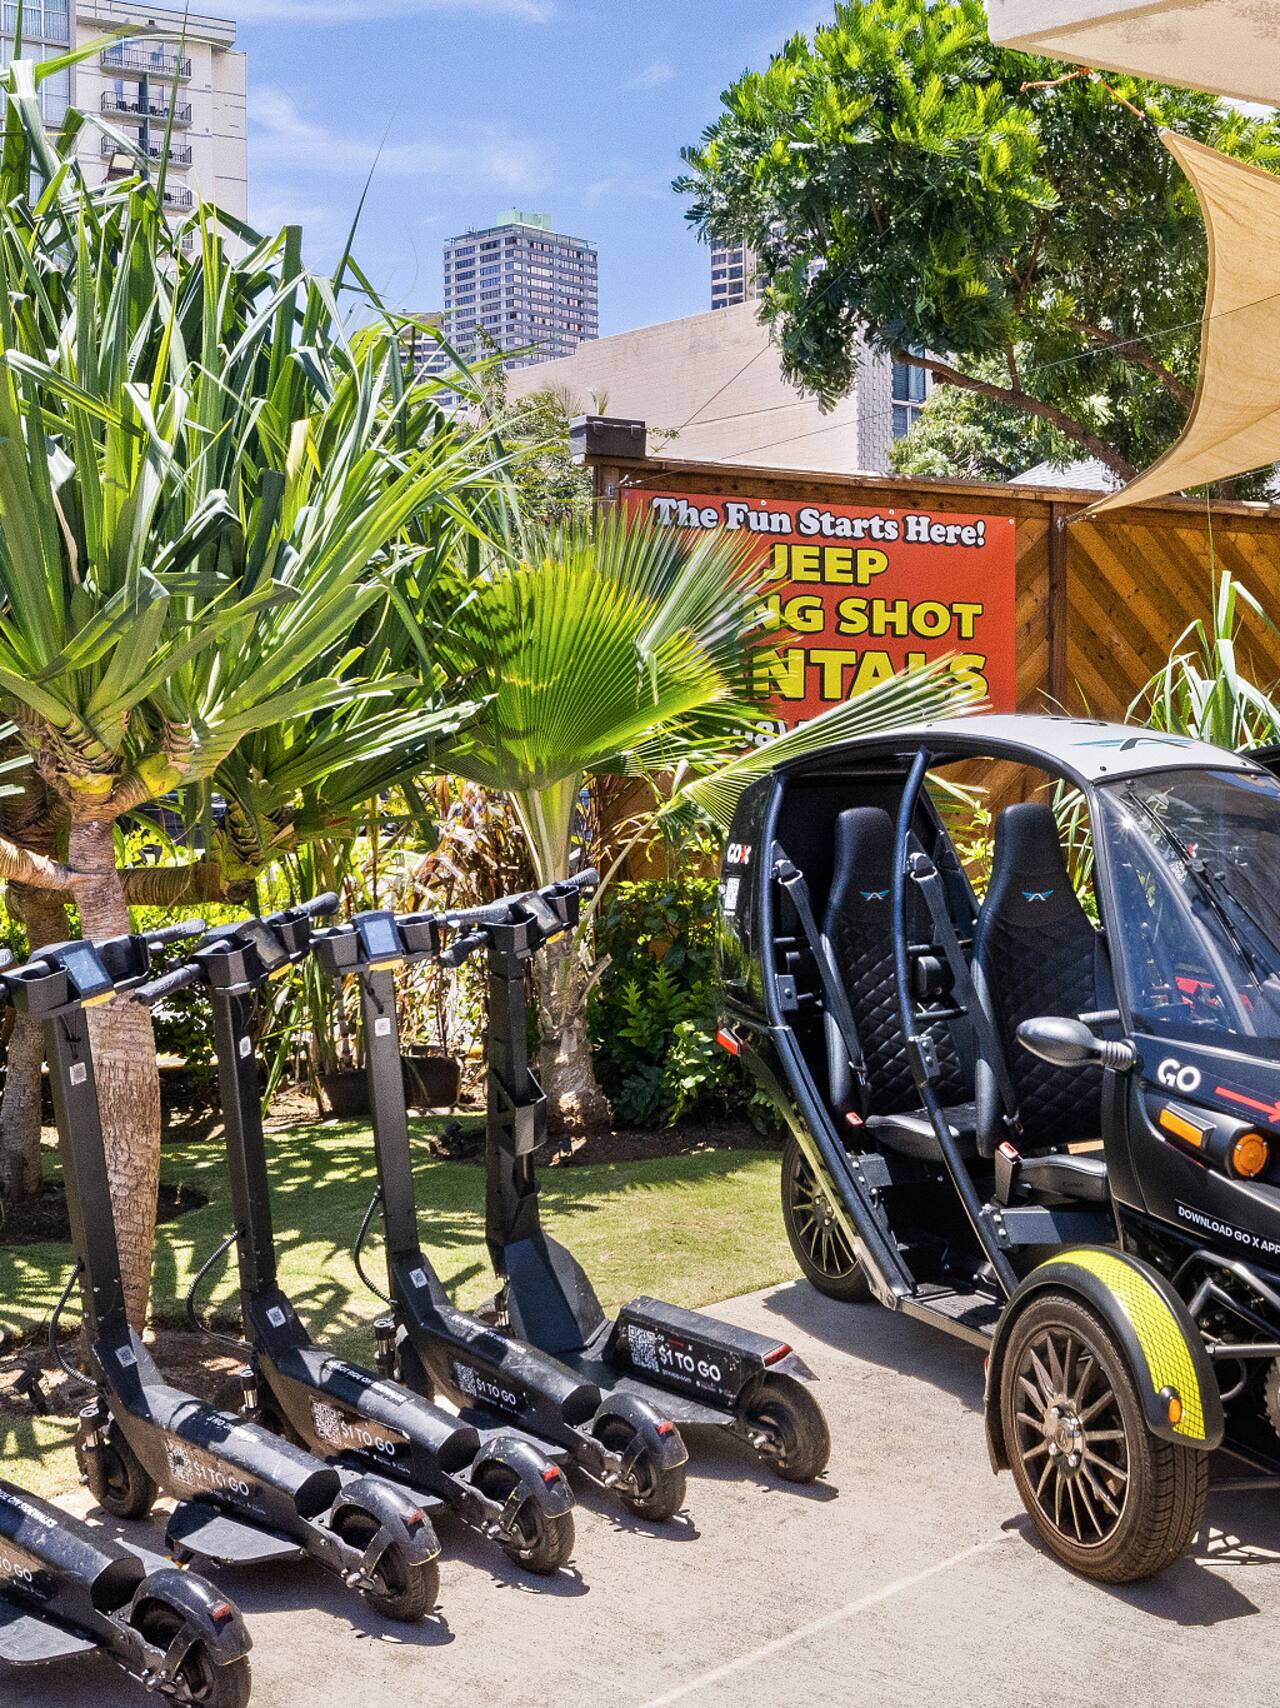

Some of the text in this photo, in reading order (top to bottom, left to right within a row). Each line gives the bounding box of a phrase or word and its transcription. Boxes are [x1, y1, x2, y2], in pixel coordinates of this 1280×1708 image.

[652, 497, 986, 546] The Fun Starts Here!
[762, 543, 889, 585] JEEP
[838, 597, 984, 639] SHOT
[750, 648, 990, 702] NTAS
[1157, 1058, 1201, 1092] GO
[1178, 1206, 1233, 1237] DOWNLOAD
[1234, 1231, 1251, 1244] GO
[1252, 1236, 1260, 1249] X
[658, 1344, 673, 1365] $1
[674, 1352, 695, 1372] TO
[697, 1361, 721, 1381] GO
[476, 1378, 486, 1392] $1
[487, 1383, 500, 1398] TO
[501, 1390, 517, 1405] GO
[341, 1421, 354, 1439] $1
[355, 1427, 372, 1446] TO
[375, 1437, 395, 1456] GO
[208, 1468, 226, 1487] TO
[228, 1477, 250, 1496] GO
[14, 1564, 32, 1582] GO
